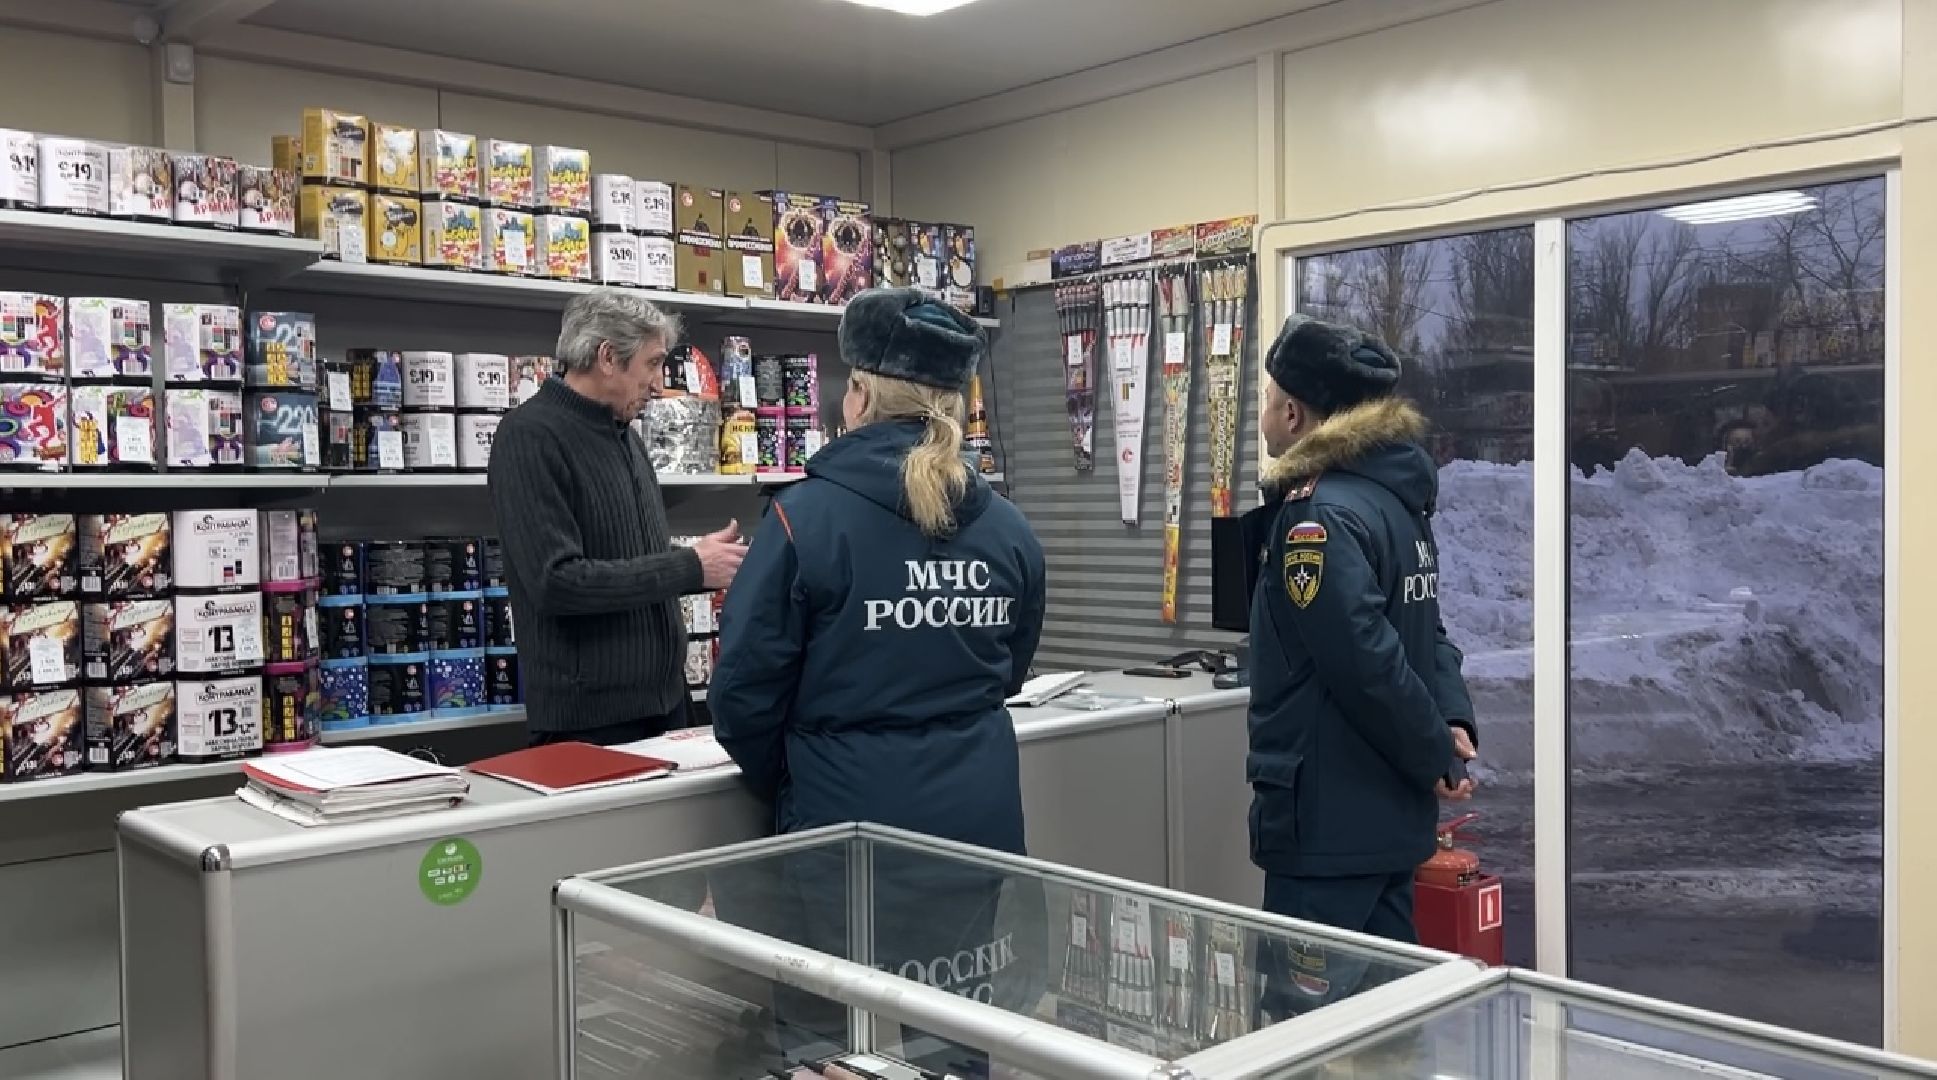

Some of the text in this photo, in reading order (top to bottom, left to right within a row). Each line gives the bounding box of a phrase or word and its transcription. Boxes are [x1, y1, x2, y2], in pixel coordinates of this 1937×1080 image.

[904, 560, 991, 591] МЧС
[863, 596, 1016, 631] РОССИИ
[208, 708, 237, 737] 13
